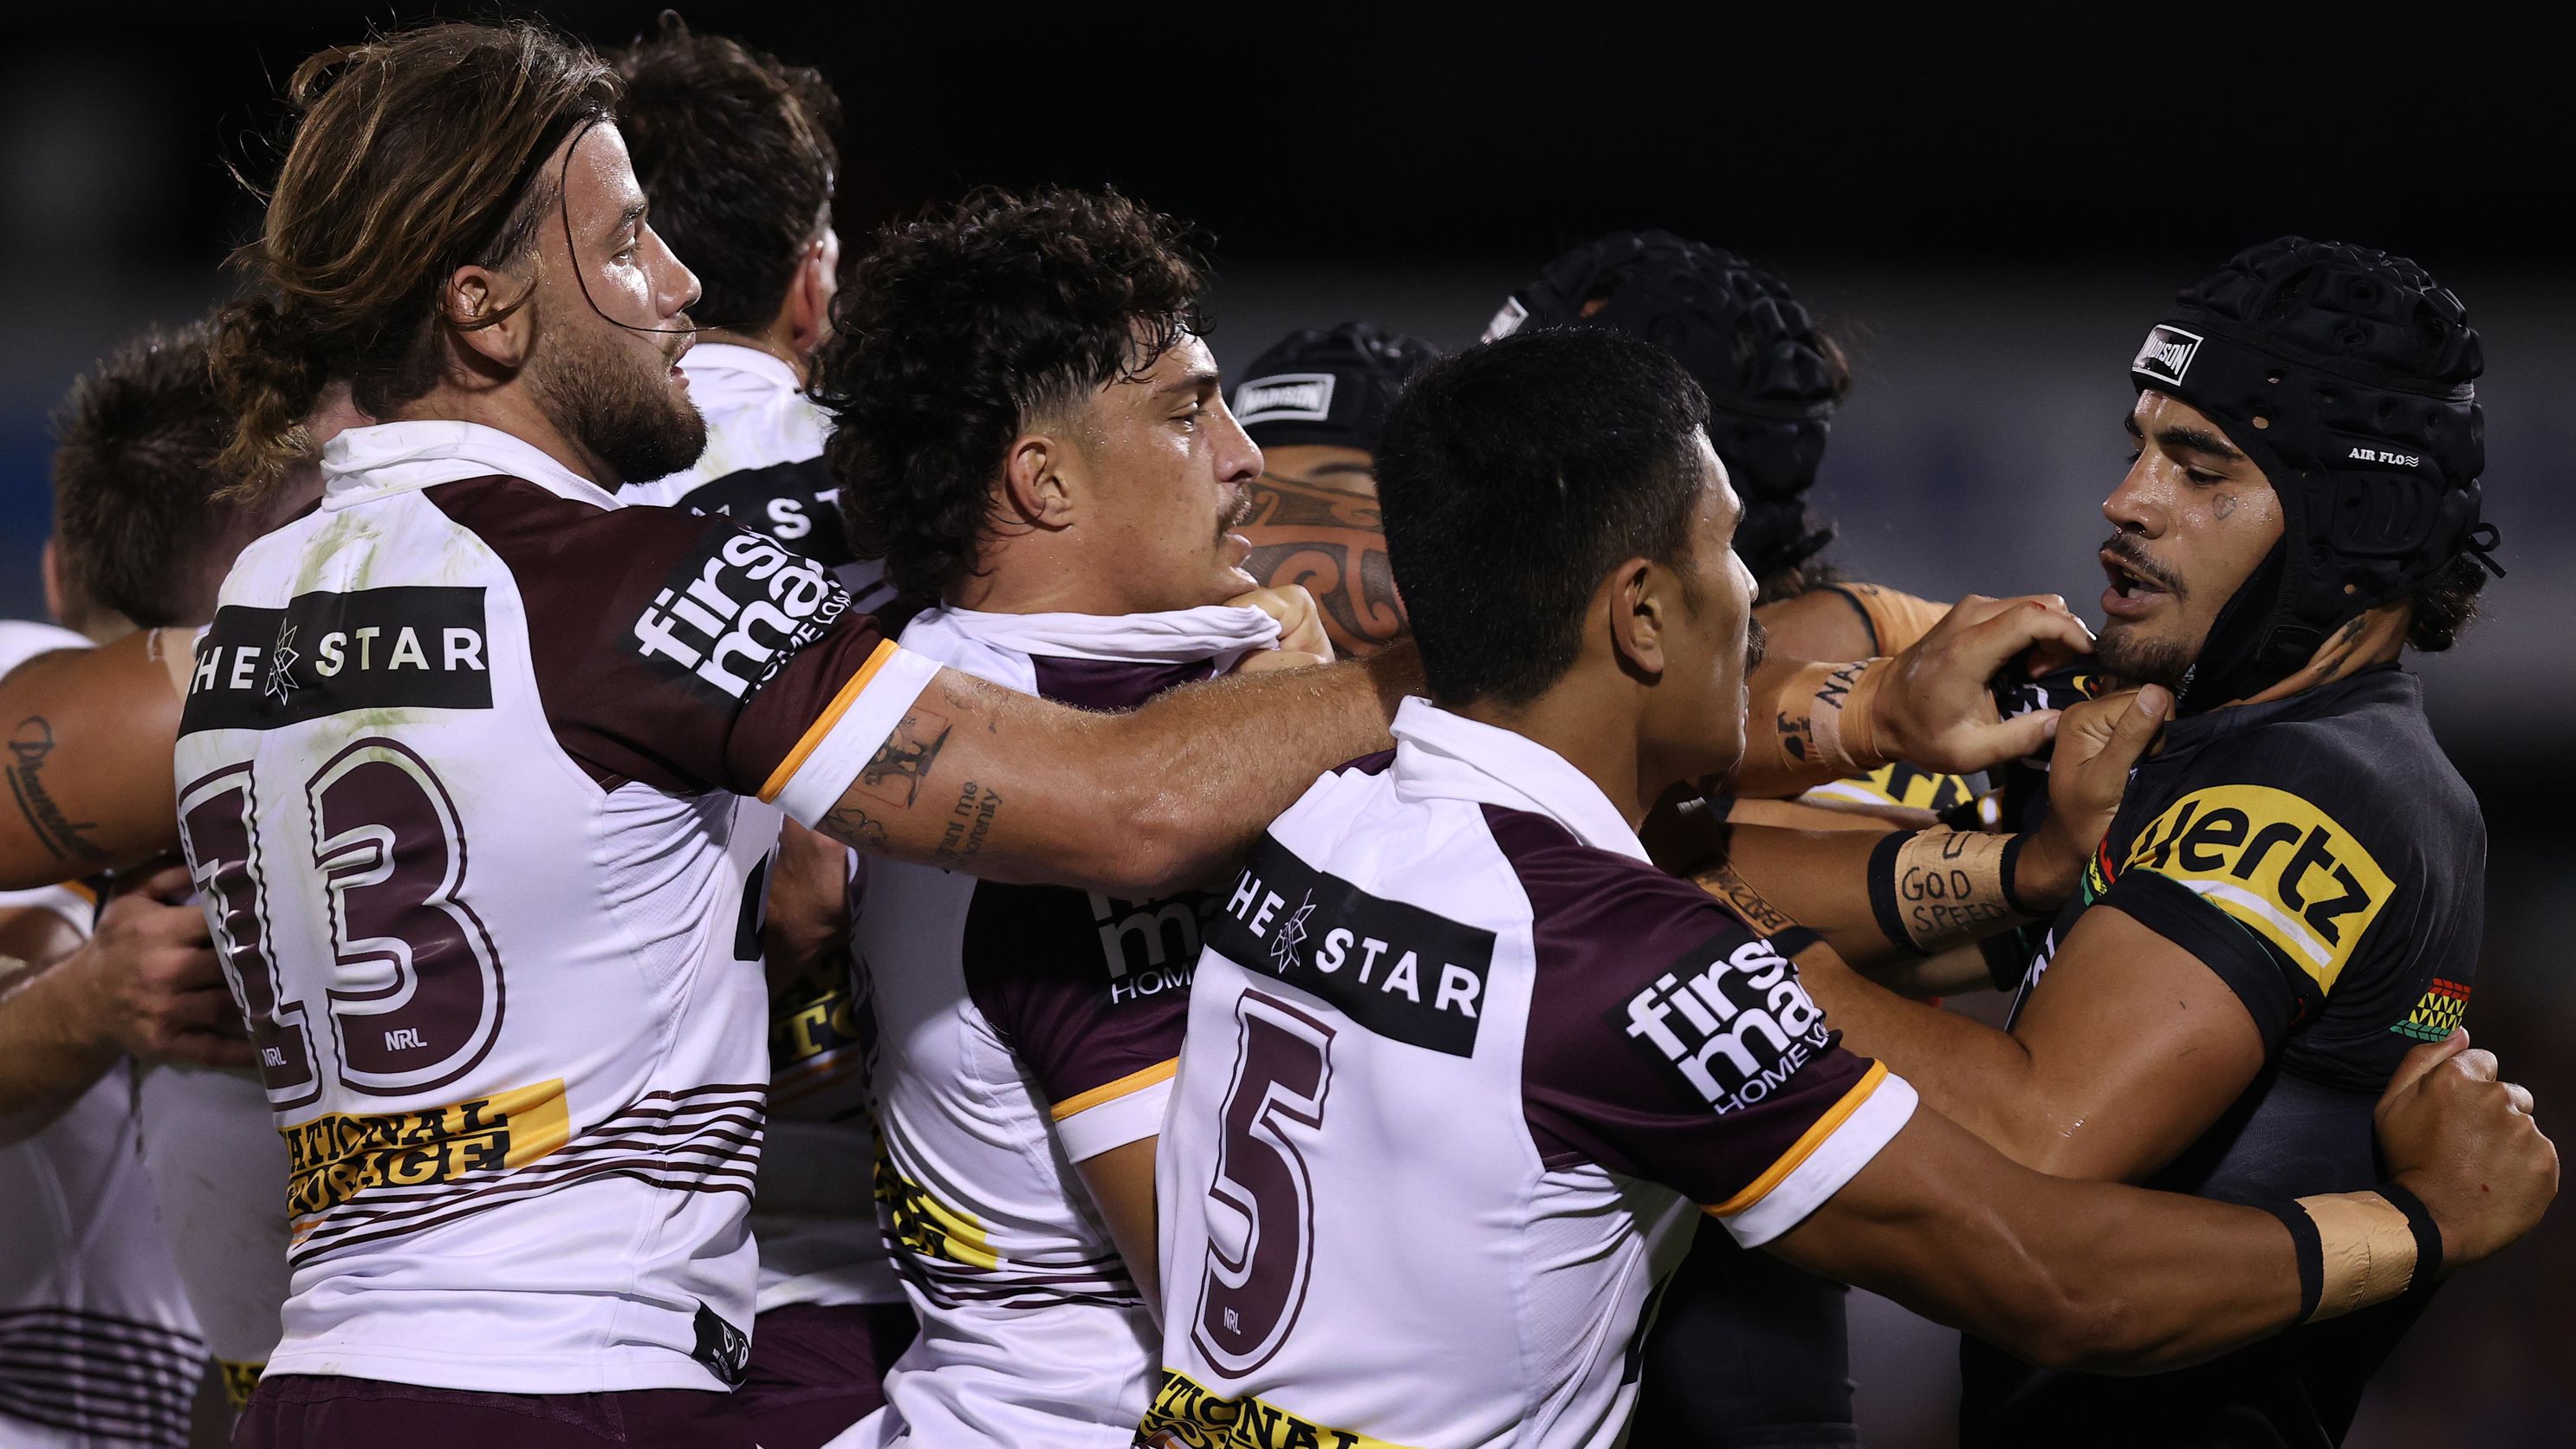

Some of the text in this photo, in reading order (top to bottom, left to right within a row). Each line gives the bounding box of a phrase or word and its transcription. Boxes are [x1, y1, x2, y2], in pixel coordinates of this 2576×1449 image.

[2348, 447, 2405, 465] AIR FLO
[633, 525, 801, 670] firs
[696, 558, 841, 699] ma
[191, 626, 488, 695] HE STAR
[1902, 867, 1972, 901] GOD
[2135, 799, 2372, 948] Hertz
[178, 736, 507, 1117] 13
[1226, 867, 1481, 1019] HE STAR
[1913, 902, 2008, 933] SPEED
[1112, 962, 1192, 1004] HOM
[1625, 939, 1790, 1062] firs
[262, 1047, 287, 1068] NRL
[384, 1028, 428, 1052] NRL
[1677, 978, 1823, 1104] ma
[1713, 1043, 1811, 1115] HOME
[279, 1100, 509, 1173] ATIONAL
[287, 1134, 496, 1215] TORAGE
[1191, 987, 1337, 1379] 5
[1223, 1306, 1242, 1335] NRL
